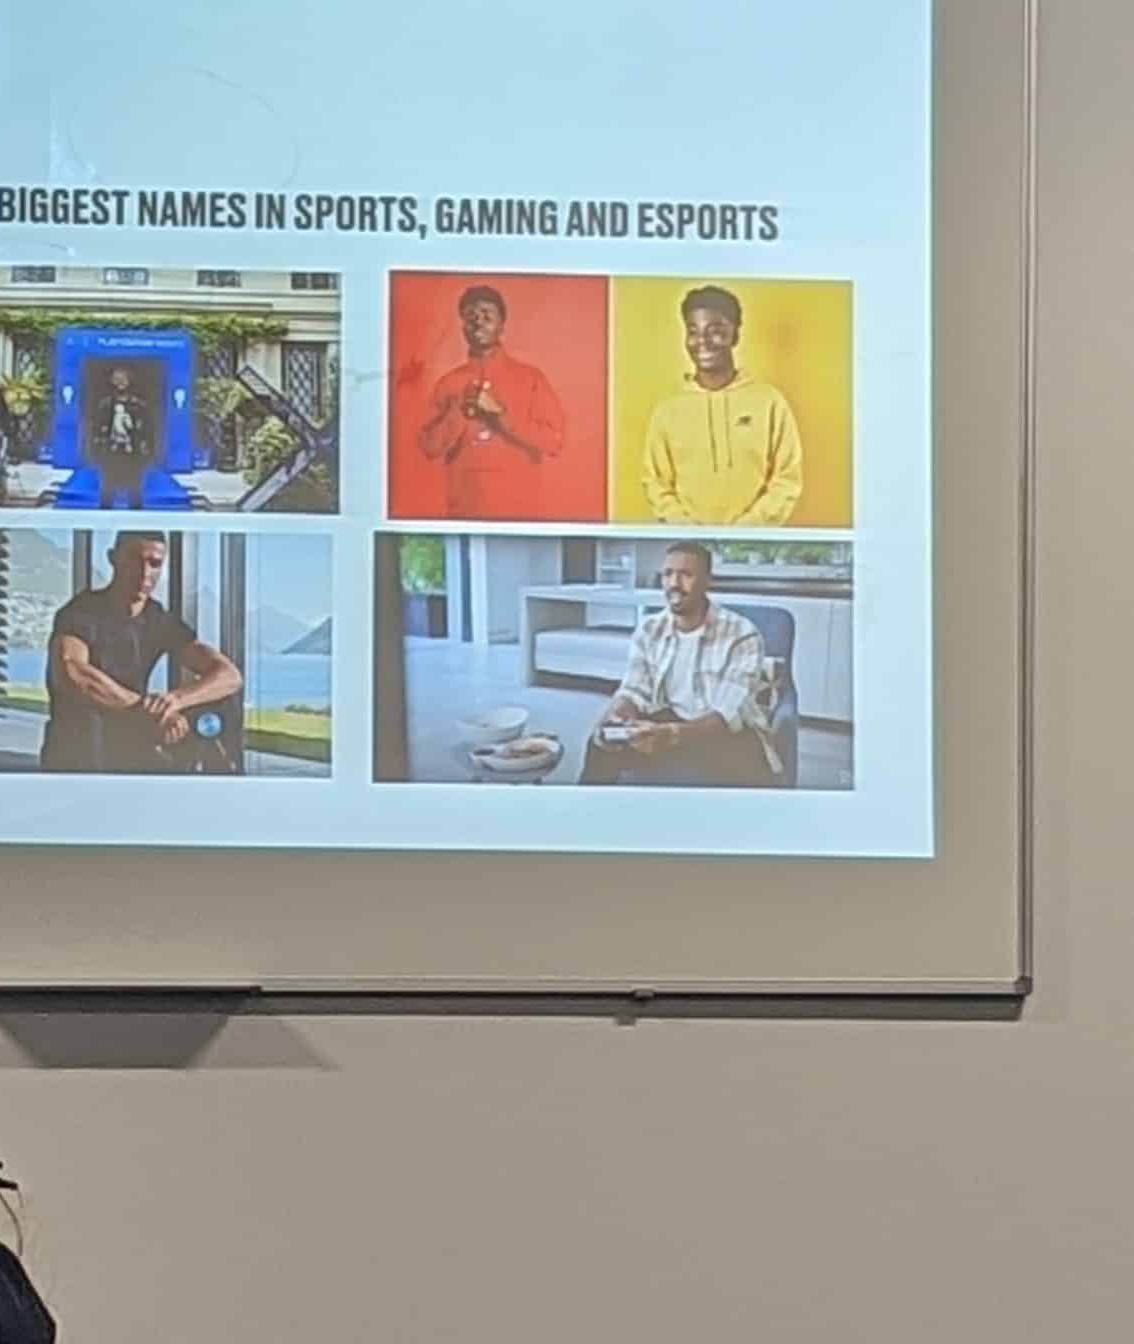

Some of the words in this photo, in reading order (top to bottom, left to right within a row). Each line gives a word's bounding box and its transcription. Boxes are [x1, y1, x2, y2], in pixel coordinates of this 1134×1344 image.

[137, 190, 247, 229] NAMES
[254, 192, 286, 230] IN
[293, 193, 428, 240] SPORTS,
[434, 197, 559, 237] GAMING
[565, 200, 629, 238] AND
[636, 202, 780, 242] ESPORTS
